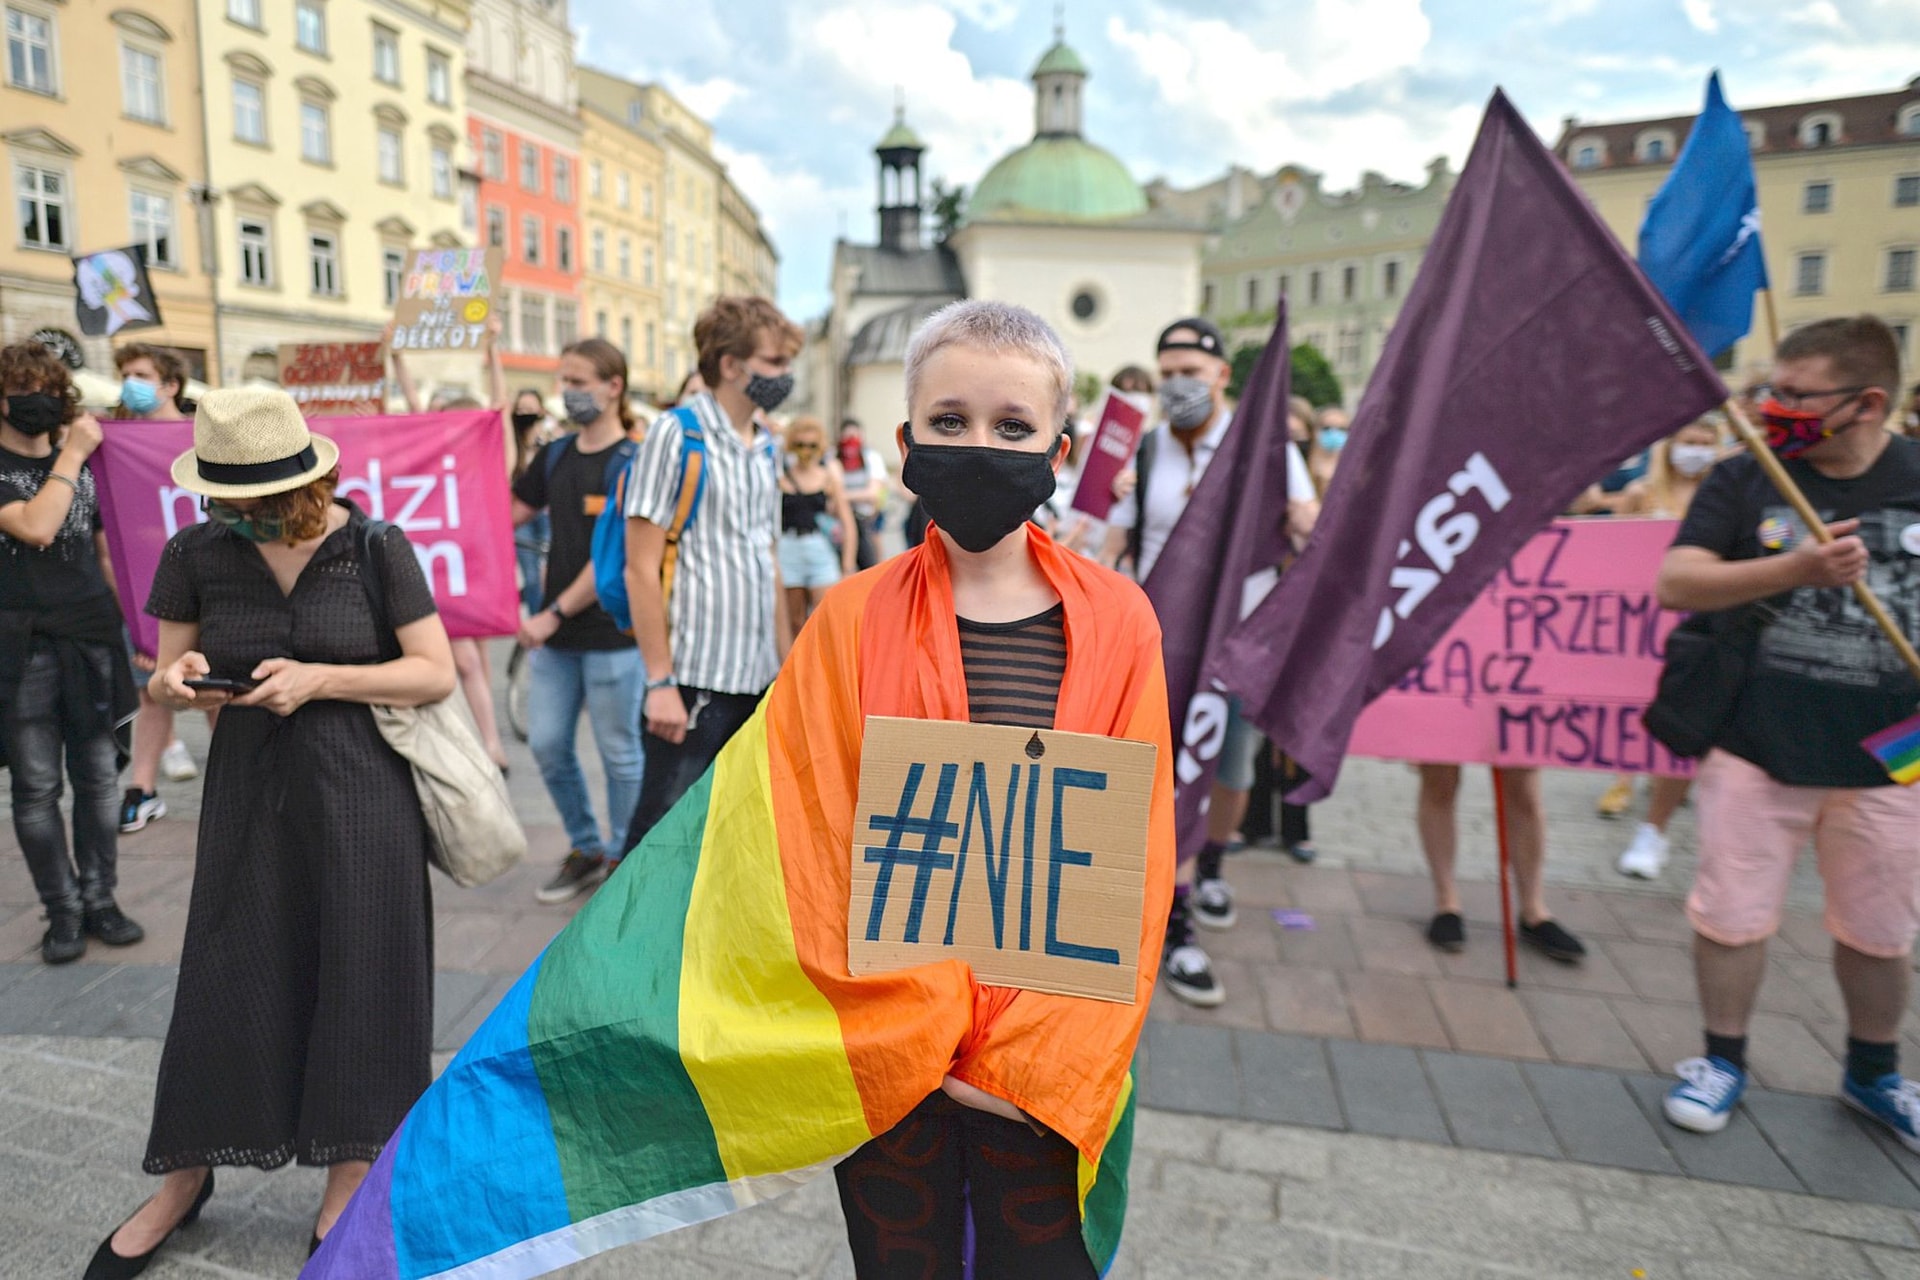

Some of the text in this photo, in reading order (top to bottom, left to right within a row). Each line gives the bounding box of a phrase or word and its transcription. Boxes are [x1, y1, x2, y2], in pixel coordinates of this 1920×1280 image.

[415, 248, 485, 273] MOJE
[403, 271, 491, 299] PRAWA
[418, 311, 456, 328] NIE
[863, 761, 1121, 966] #NIE
